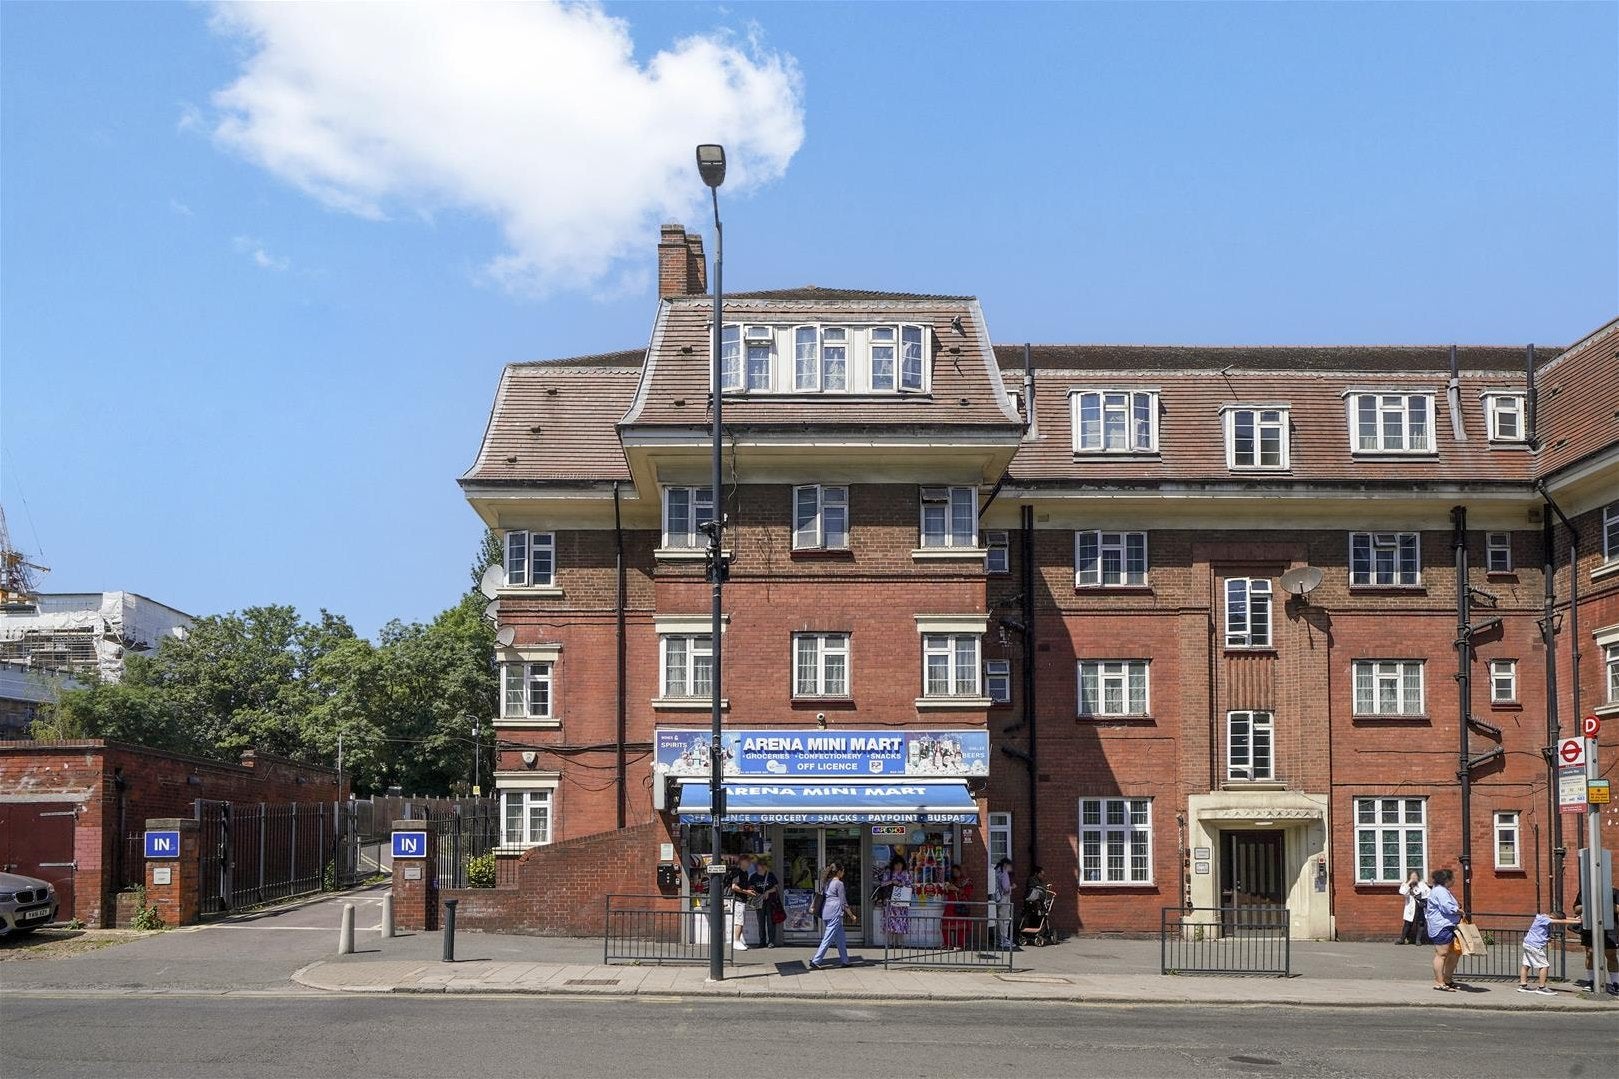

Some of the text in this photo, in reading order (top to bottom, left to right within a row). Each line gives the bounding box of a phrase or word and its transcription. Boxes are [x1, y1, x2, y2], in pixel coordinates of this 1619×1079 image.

[1586, 719, 1597, 733] D
[743, 737, 902, 751] ARENA MINI MART
[726, 787, 927, 796] ARENA MINI MART
[761, 814, 808, 822] GROCERY
[818, 814, 858, 822] SNACKS
[868, 814, 919, 822] PAYPOINT
[154, 838, 170, 851] IN
[401, 838, 417, 852] IN
